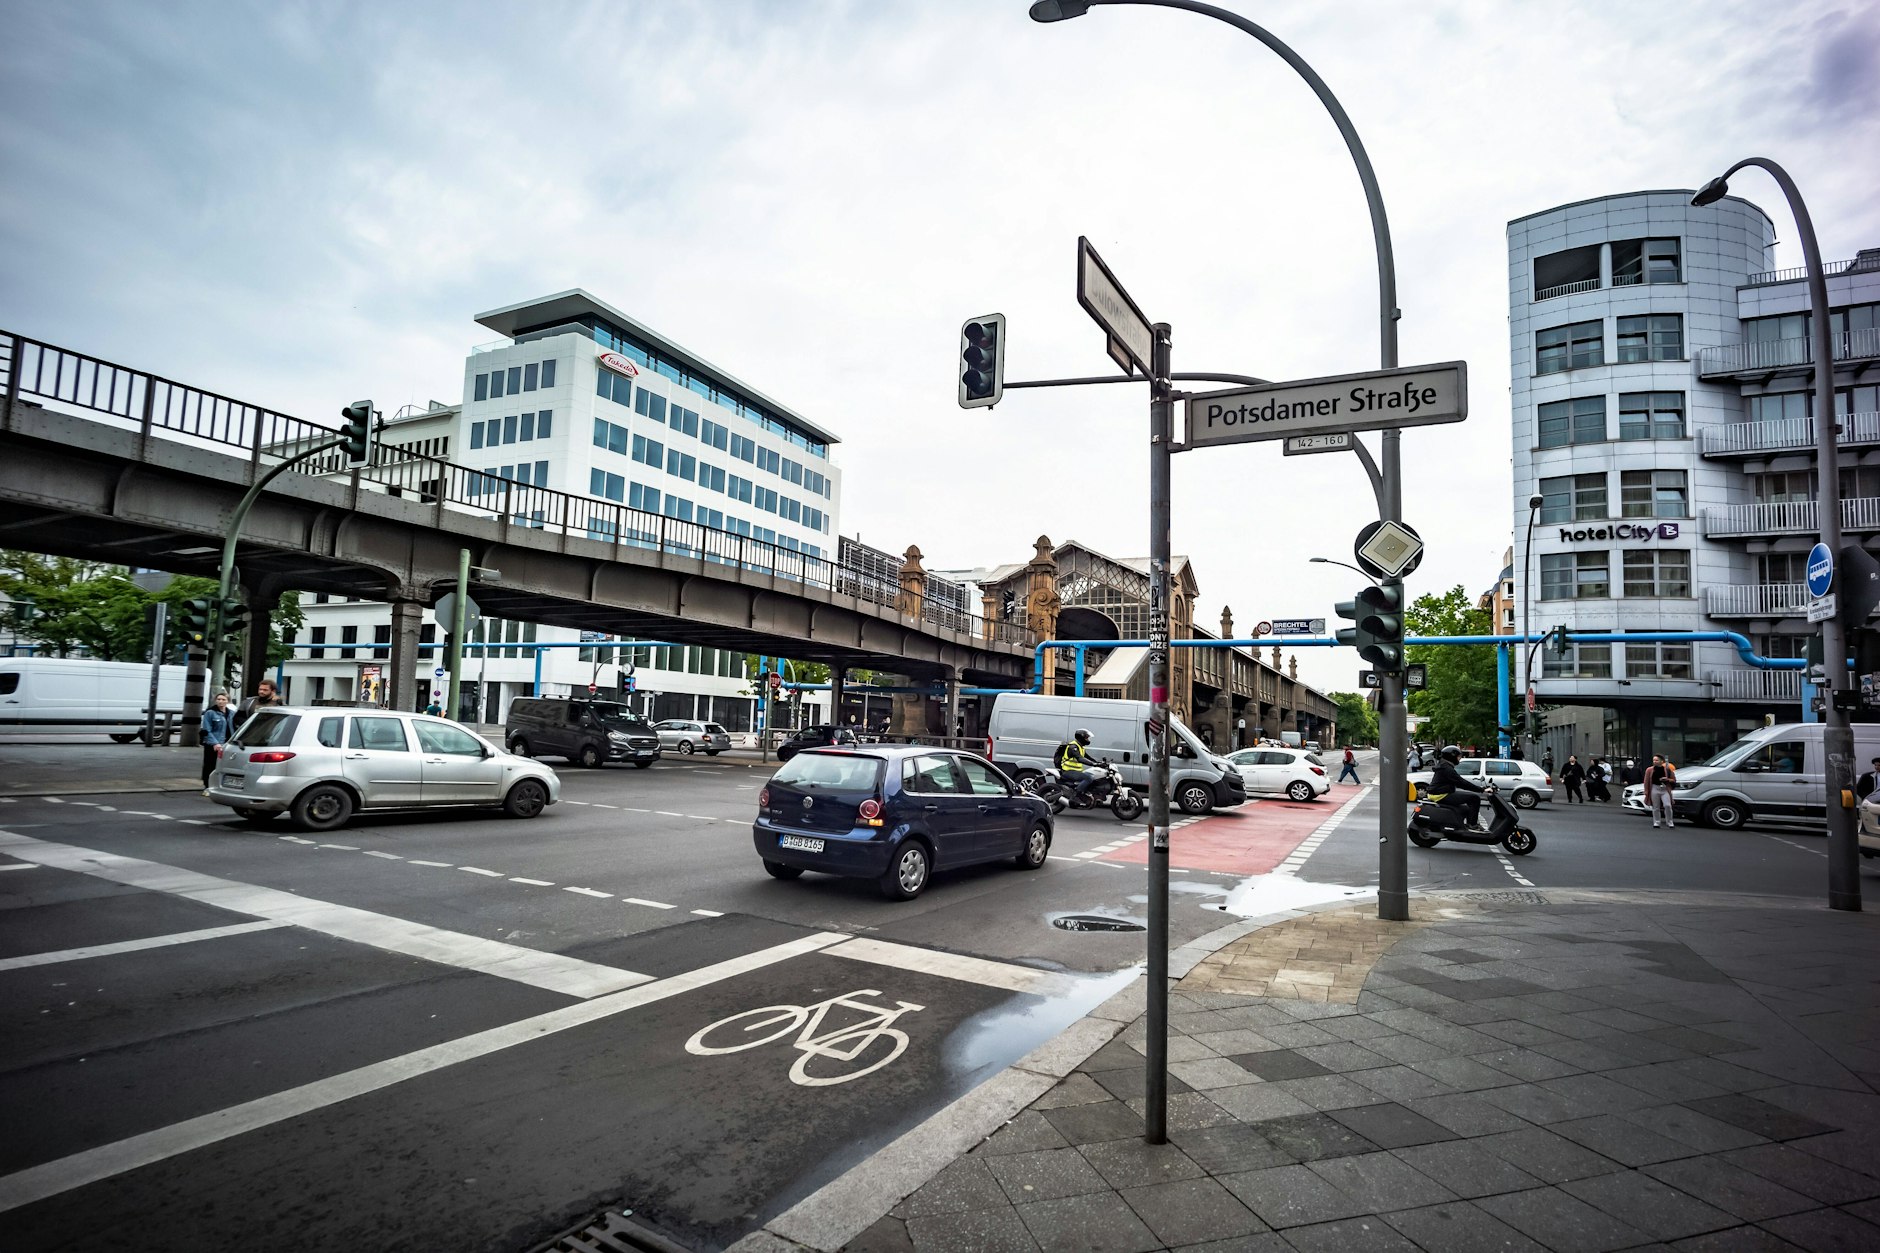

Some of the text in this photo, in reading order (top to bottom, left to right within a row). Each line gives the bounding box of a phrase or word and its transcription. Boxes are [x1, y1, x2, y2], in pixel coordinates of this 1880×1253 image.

[608, 356, 633, 372] Takeda
[1207, 381, 1437, 428] Potsdamer Straße
[1297, 438, 1313, 448] 142
[1325, 435, 1344, 445] 160
[784, 835, 789, 845] B
[804, 839, 823, 850] 8165
